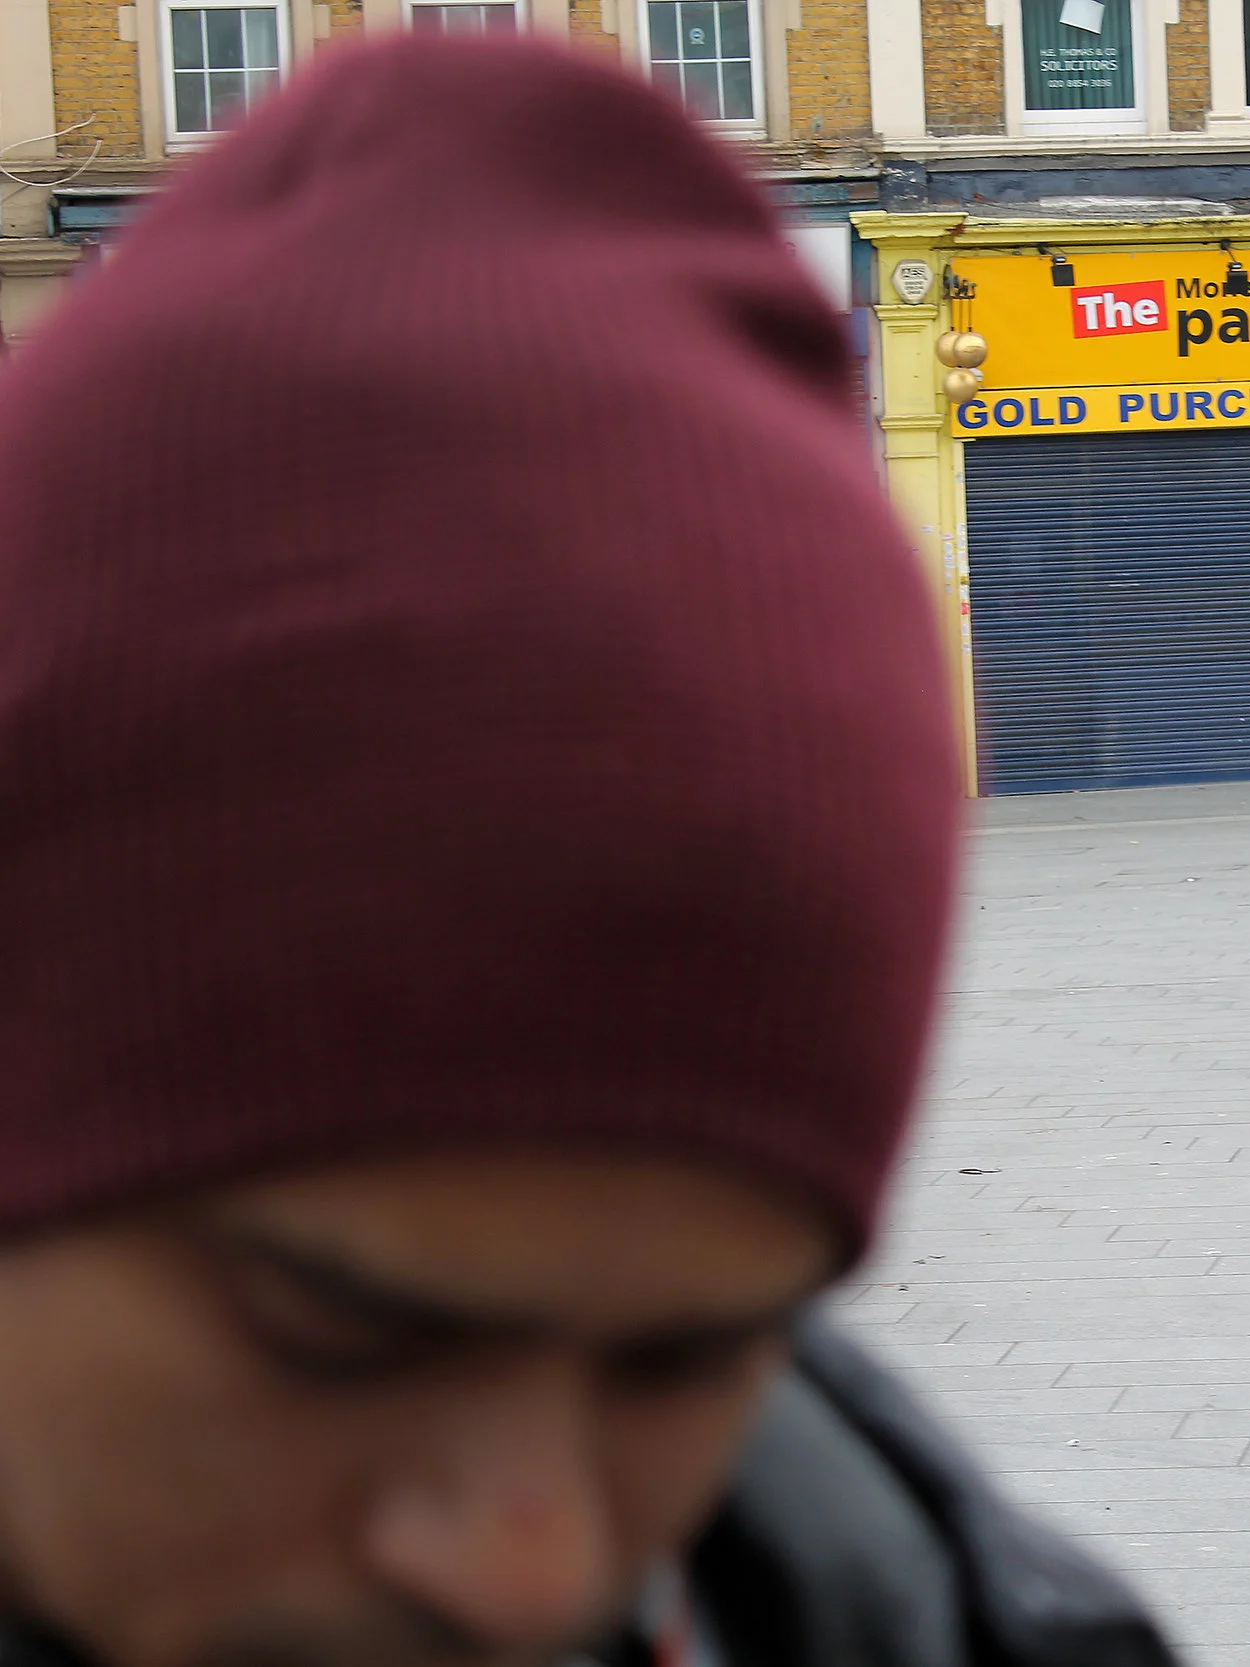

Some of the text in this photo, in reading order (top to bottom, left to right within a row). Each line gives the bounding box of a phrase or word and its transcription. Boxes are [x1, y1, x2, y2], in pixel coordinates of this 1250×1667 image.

[1059, 47, 1094, 56] THOMAS
[1040, 60, 1119, 72] SOLICITORS
[1076, 292, 1160, 330] The
[956, 395, 1087, 429] GOLD
